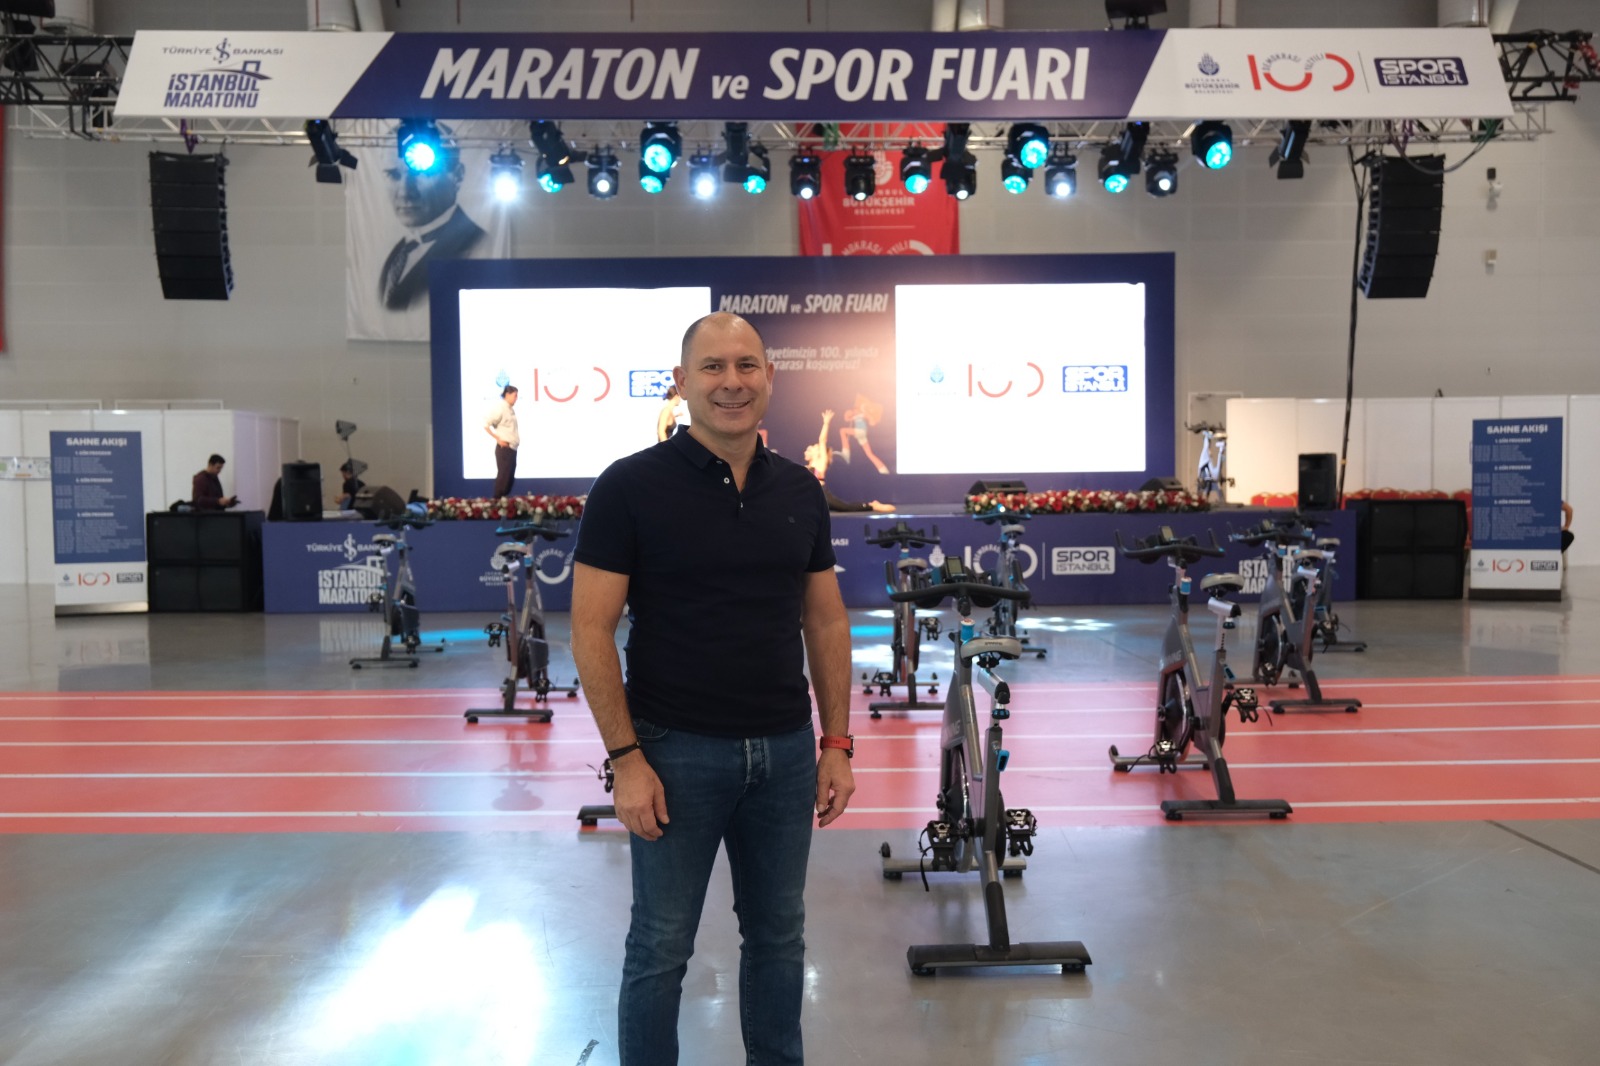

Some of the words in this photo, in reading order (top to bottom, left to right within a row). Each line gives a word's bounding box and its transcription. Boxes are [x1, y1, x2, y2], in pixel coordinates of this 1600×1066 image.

[420, 47, 700, 99] MARATON
[711, 71, 749, 99] ve
[763, 47, 913, 102] SPOR
[926, 47, 1090, 100] FUARI
[1380, 59, 1460, 75] SPOR
[168, 73, 261, 91] İSTANBUL
[163, 92, 259, 108] MARATONU
[719, 294, 789, 314] MARATON
[791, 302, 802, 313] ve
[803, 293, 844, 314] SPOR
[845, 293, 889, 313] FUARI
[766, 346, 817, 361] iyetimizin
[774, 360, 805, 371] rarası
[631, 371, 673, 385] SPO
[1486, 424, 1520, 435] SAHNE
[1521, 423, 1549, 435] AKIŞI
[66, 437, 100, 447] SAHNE
[101, 437, 128, 448] AKIŞI
[1056, 550, 1111, 563] SPOR
